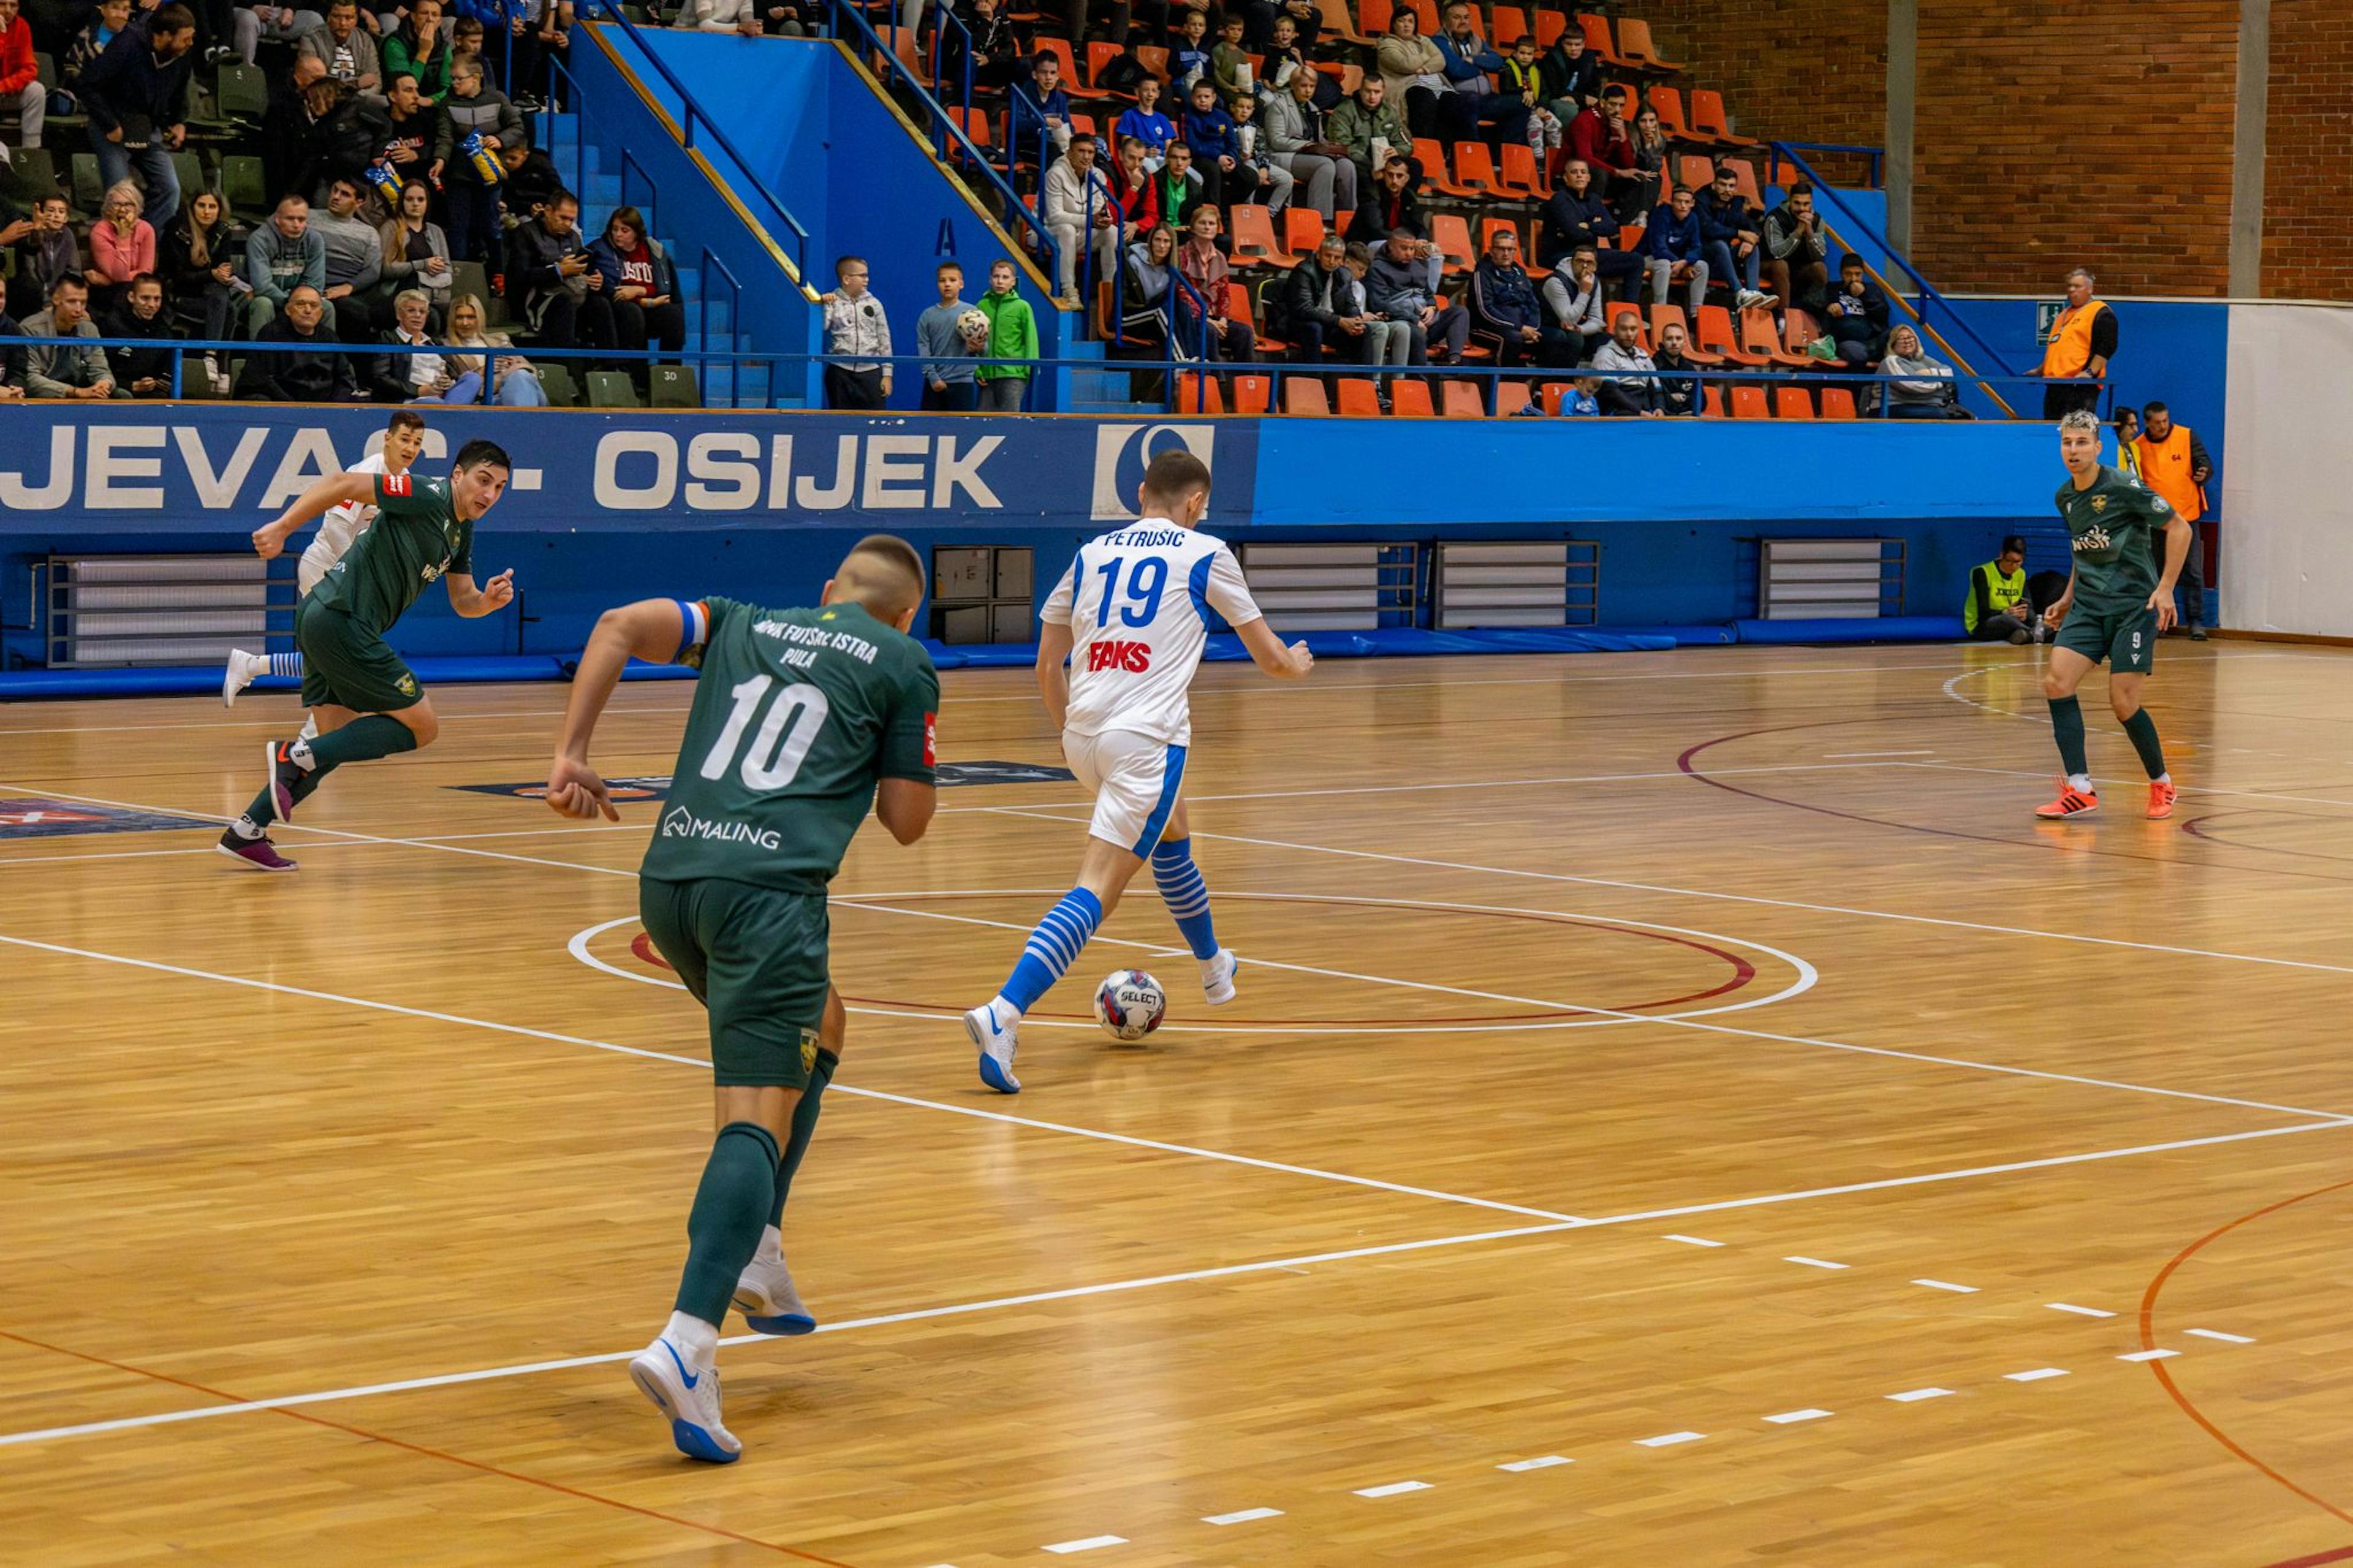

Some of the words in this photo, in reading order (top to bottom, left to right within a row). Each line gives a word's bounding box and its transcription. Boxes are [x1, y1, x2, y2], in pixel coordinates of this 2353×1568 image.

[935, 218, 956, 256] A
[621, 261, 652, 283] OSTO
[664, 372, 676, 381] 30
[593, 430, 1006, 510] OSIJEK
[1104, 528, 1185, 547] PETRUŠIĆ
[1097, 556, 1168, 627] 19
[830, 632, 878, 665] ISTRA
[2132, 632, 2141, 648] 9
[779, 648, 817, 668] PULA
[1089, 640, 1151, 673] FAKS
[700, 675, 828, 790] 10
[690, 818, 781, 850] MALING
[1121, 991, 1157, 1006] SELECT
